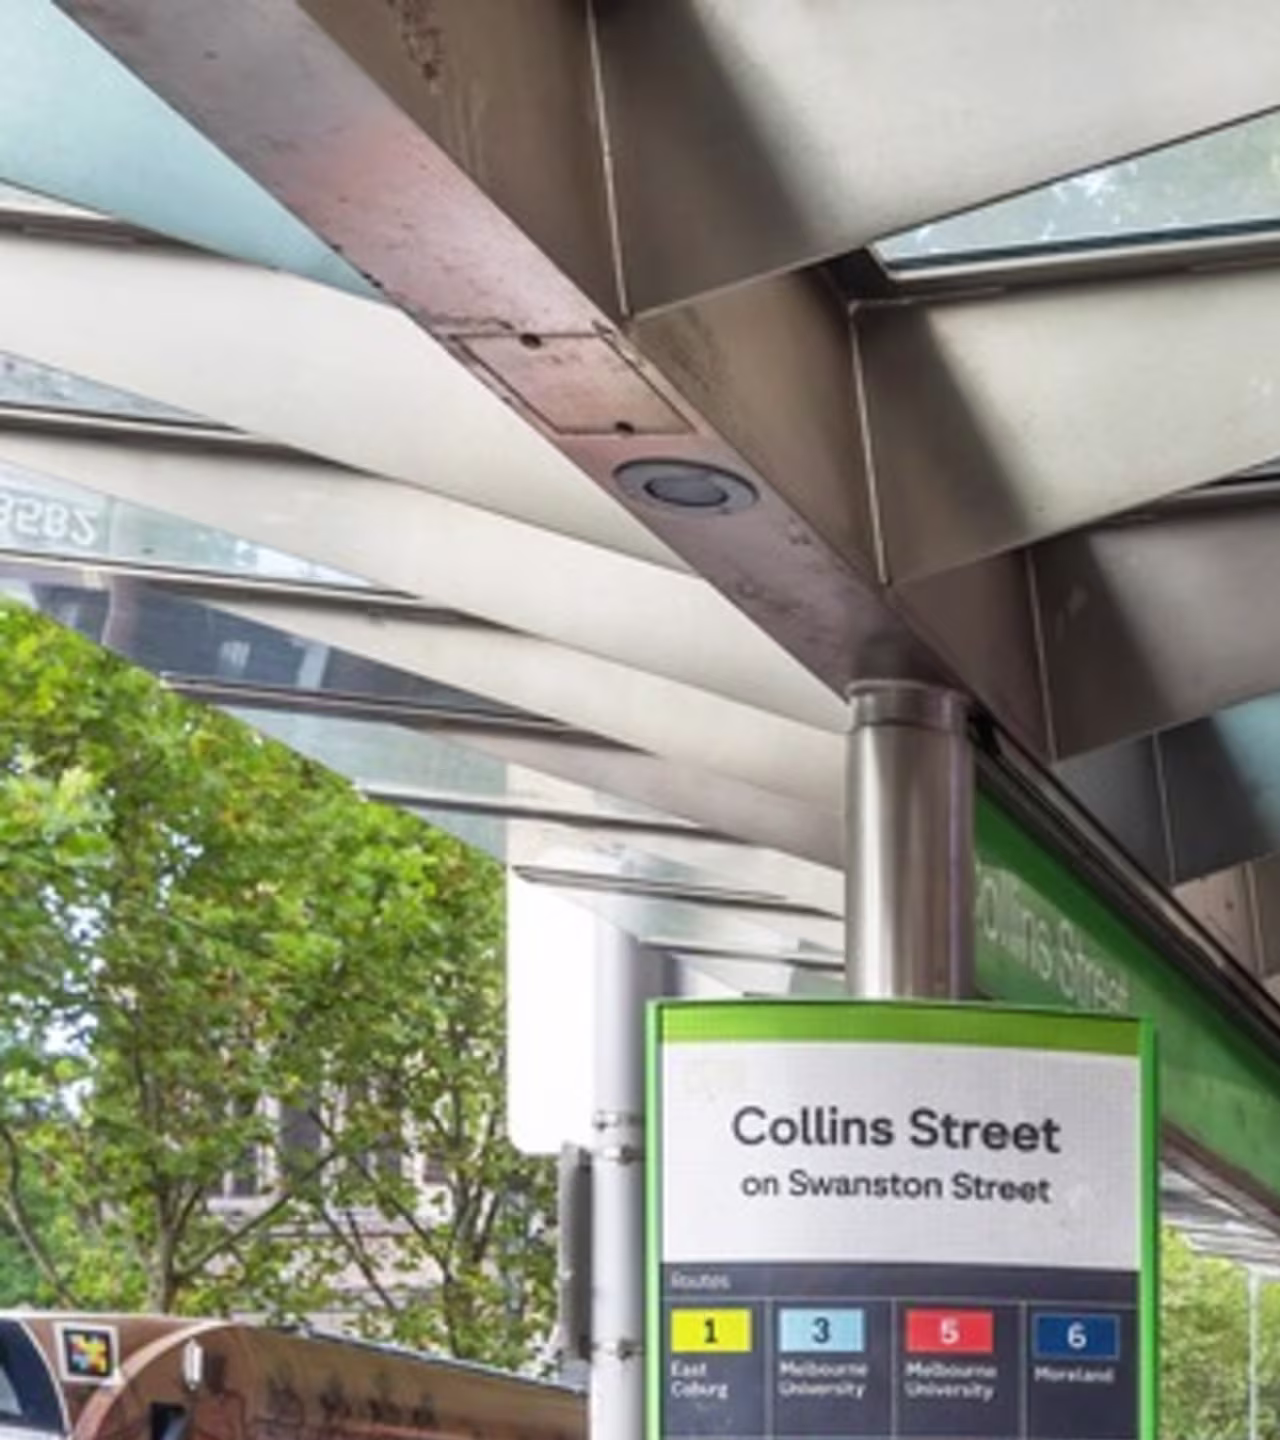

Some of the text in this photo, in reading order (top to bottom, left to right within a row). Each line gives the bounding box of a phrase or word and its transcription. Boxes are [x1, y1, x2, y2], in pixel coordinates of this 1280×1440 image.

[975, 861, 1053, 981] ollins
[732, 1105, 1062, 1154] Collins Street
[742, 1168, 1051, 1204] on Swanston Street
[704, 1318, 719, 1343] 1
[811, 1317, 831, 1344] 3
[940, 1317, 960, 1345] 5
[1067, 1321, 1087, 1349] 6
[671, 1361, 707, 1377] East
[778, 1361, 868, 1378] Melbourne
[905, 1362, 997, 1379] Melbourne
[1034, 1366, 1115, 1384] Moreland
[671, 1381, 729, 1399] Coburg
[778, 1381, 868, 1399] University
[904, 1382, 994, 1402] University
